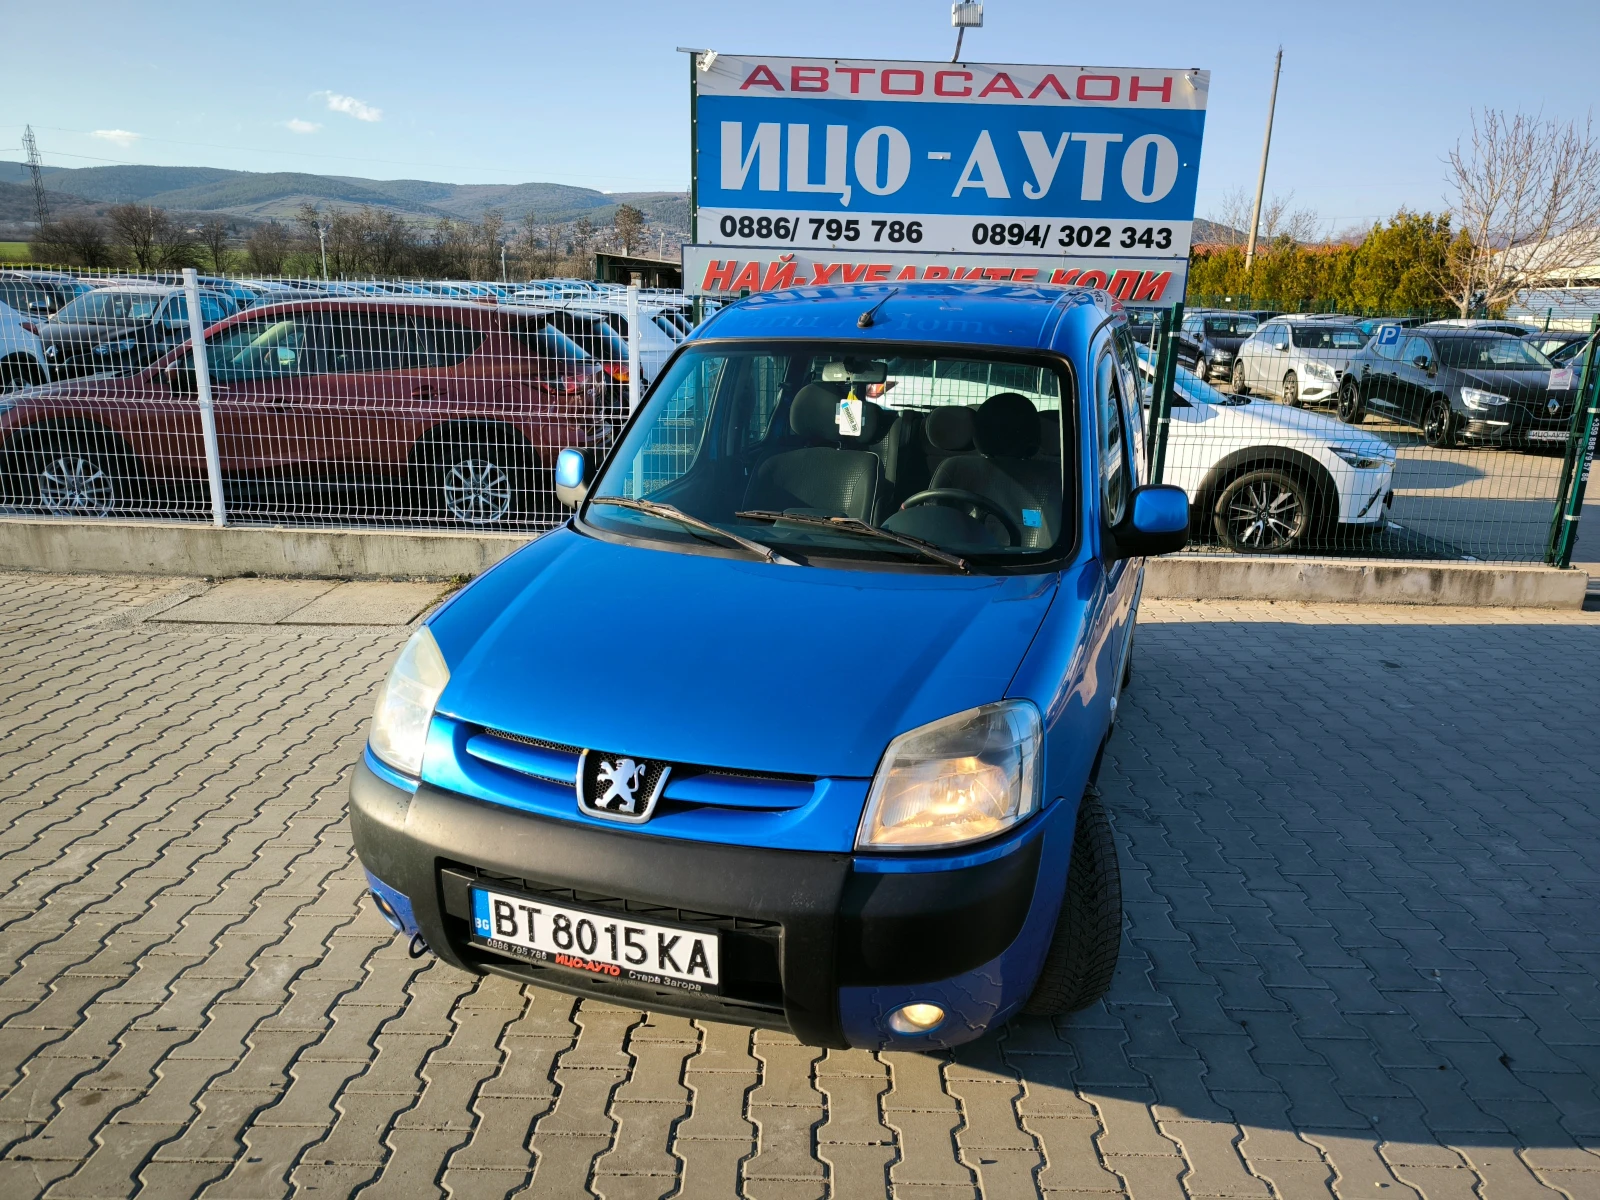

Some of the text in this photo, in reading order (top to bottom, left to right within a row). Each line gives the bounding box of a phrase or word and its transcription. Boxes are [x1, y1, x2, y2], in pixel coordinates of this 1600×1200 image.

[739, 64, 1173, 103] АВТОСАЛОН
[720, 215, 1173, 249] 0886/ 795 786 0894/ 302 343
[1382, 328, 1396, 343] P
[1590, 418, 1600, 435] +359
[1587, 437, 1596, 450] 886
[1585, 451, 1593, 460] 79
[1582, 462, 1591, 471] 57
[475, 918, 489, 930] BG
[552, 913, 648, 965] 8015
[487, 938, 702, 991] 0886 795 786 ИЦО-АУТО Стара Загора
